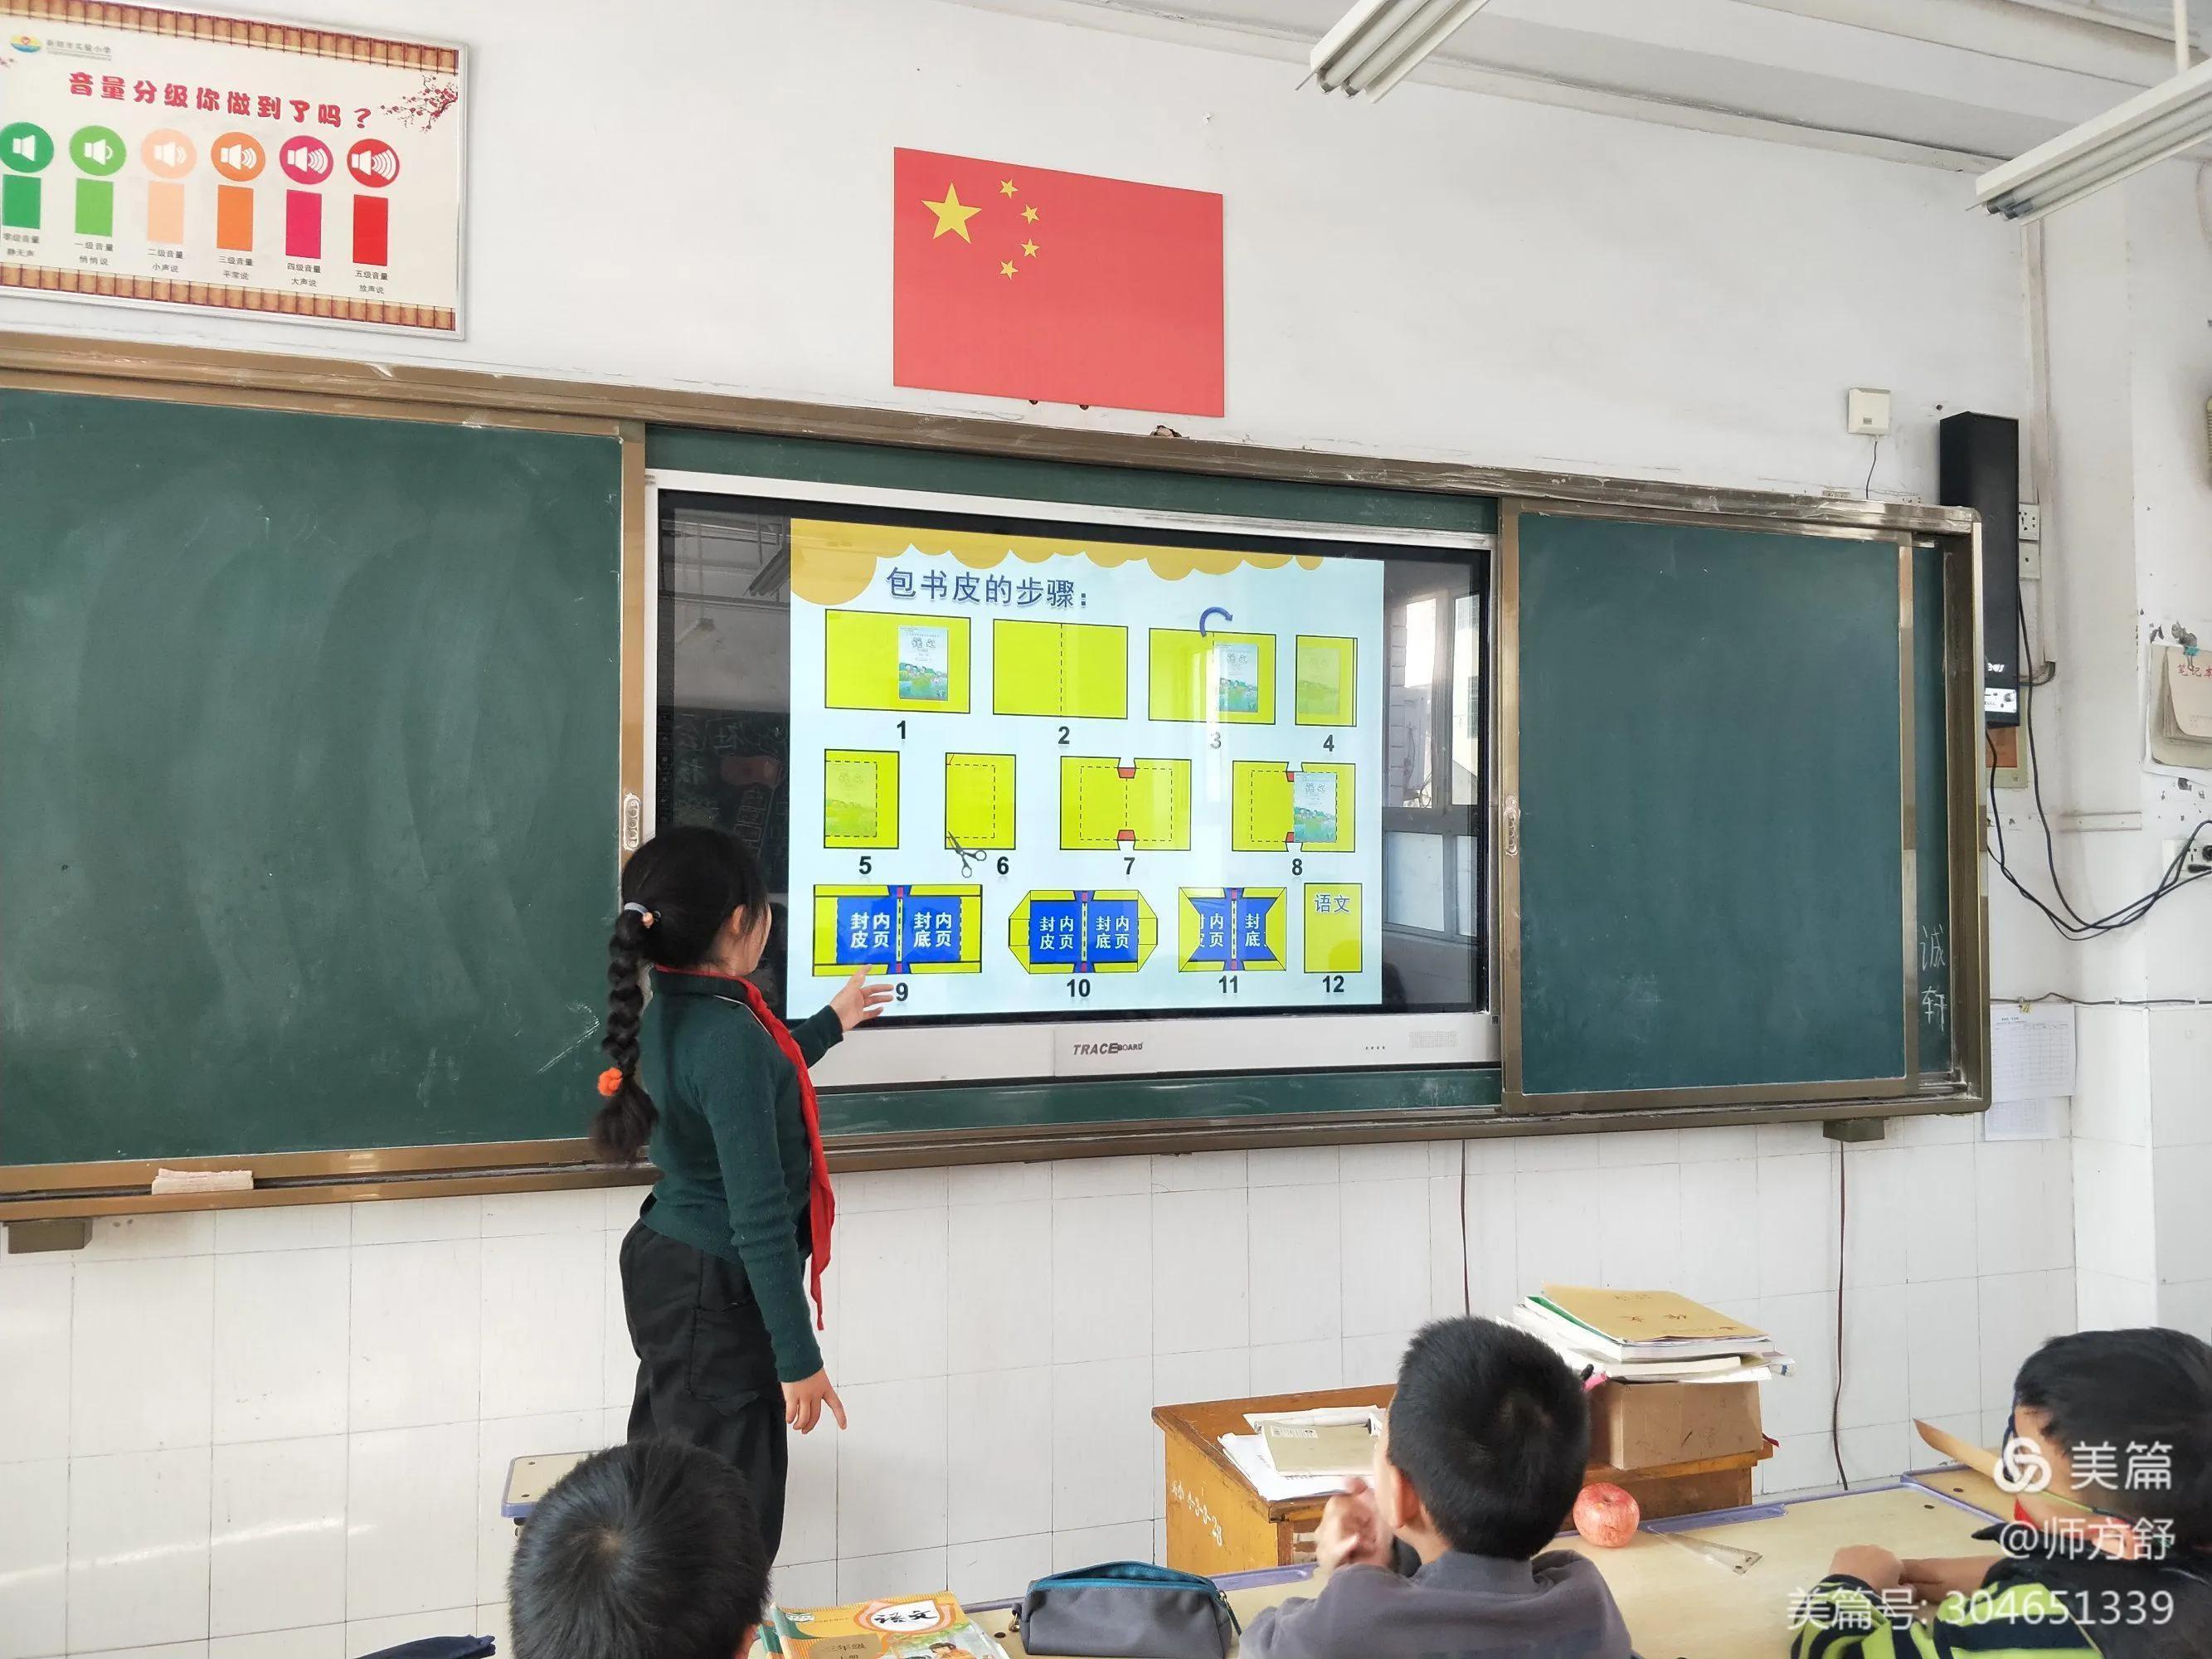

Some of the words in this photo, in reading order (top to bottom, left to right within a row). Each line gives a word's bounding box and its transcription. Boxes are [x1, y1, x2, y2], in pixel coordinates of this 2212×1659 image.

[69, 71, 372, 129] 音量分级你做到了吗？
[75, 241, 114, 252] 一级音量
[147, 249, 184, 259] 二级音量
[152, 263, 179, 273] 小声说
[219, 255, 253, 266] 三级音量
[287, 262, 321, 273] 四级音量
[223, 270, 250, 280] 平常说
[291, 278, 318, 287] 大声说
[355, 270, 388, 280] 五级音量
[886, 567, 1087, 608] 包书皮的步骤：
[897, 720, 907, 739] 1
[1057, 727, 1070, 744] 2
[1210, 732, 1222, 749] 3
[1323, 734, 1334, 752] 4
[858, 856, 872, 875] 5
[997, 856, 1009, 875] 6
[1123, 857, 1135, 875] 7
[1291, 859, 1303, 876] 8
[1314, 893, 1350, 913] 语文
[896, 982, 909, 1002] 9
[1067, 979, 1091, 998] 10
[1218, 975, 1238, 994] 11
[1322, 975, 1344, 993] 12
[873, 1610, 938, 1624] 语文
